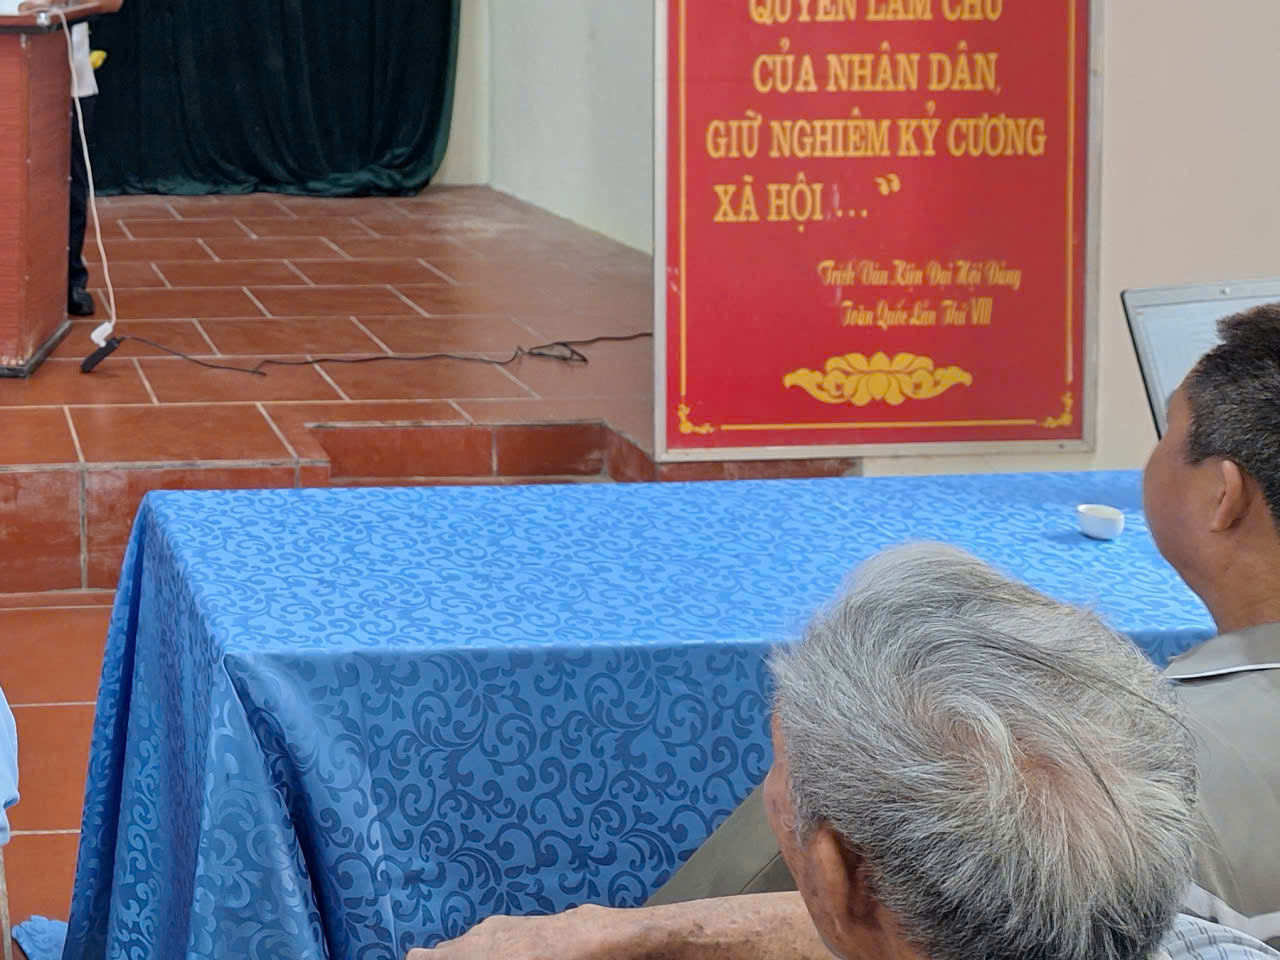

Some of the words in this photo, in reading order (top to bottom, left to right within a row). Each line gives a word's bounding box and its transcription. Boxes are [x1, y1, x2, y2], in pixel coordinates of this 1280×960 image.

[754, 38, 818, 92] CỦA
[826, 41, 920, 92] NHÂN
[770, 107, 890, 157] NGHIÊM
[898, 101, 941, 157] KỶ
[947, 115, 1047, 157] CƯƠNG
[767, 172, 824, 232] HỘI
